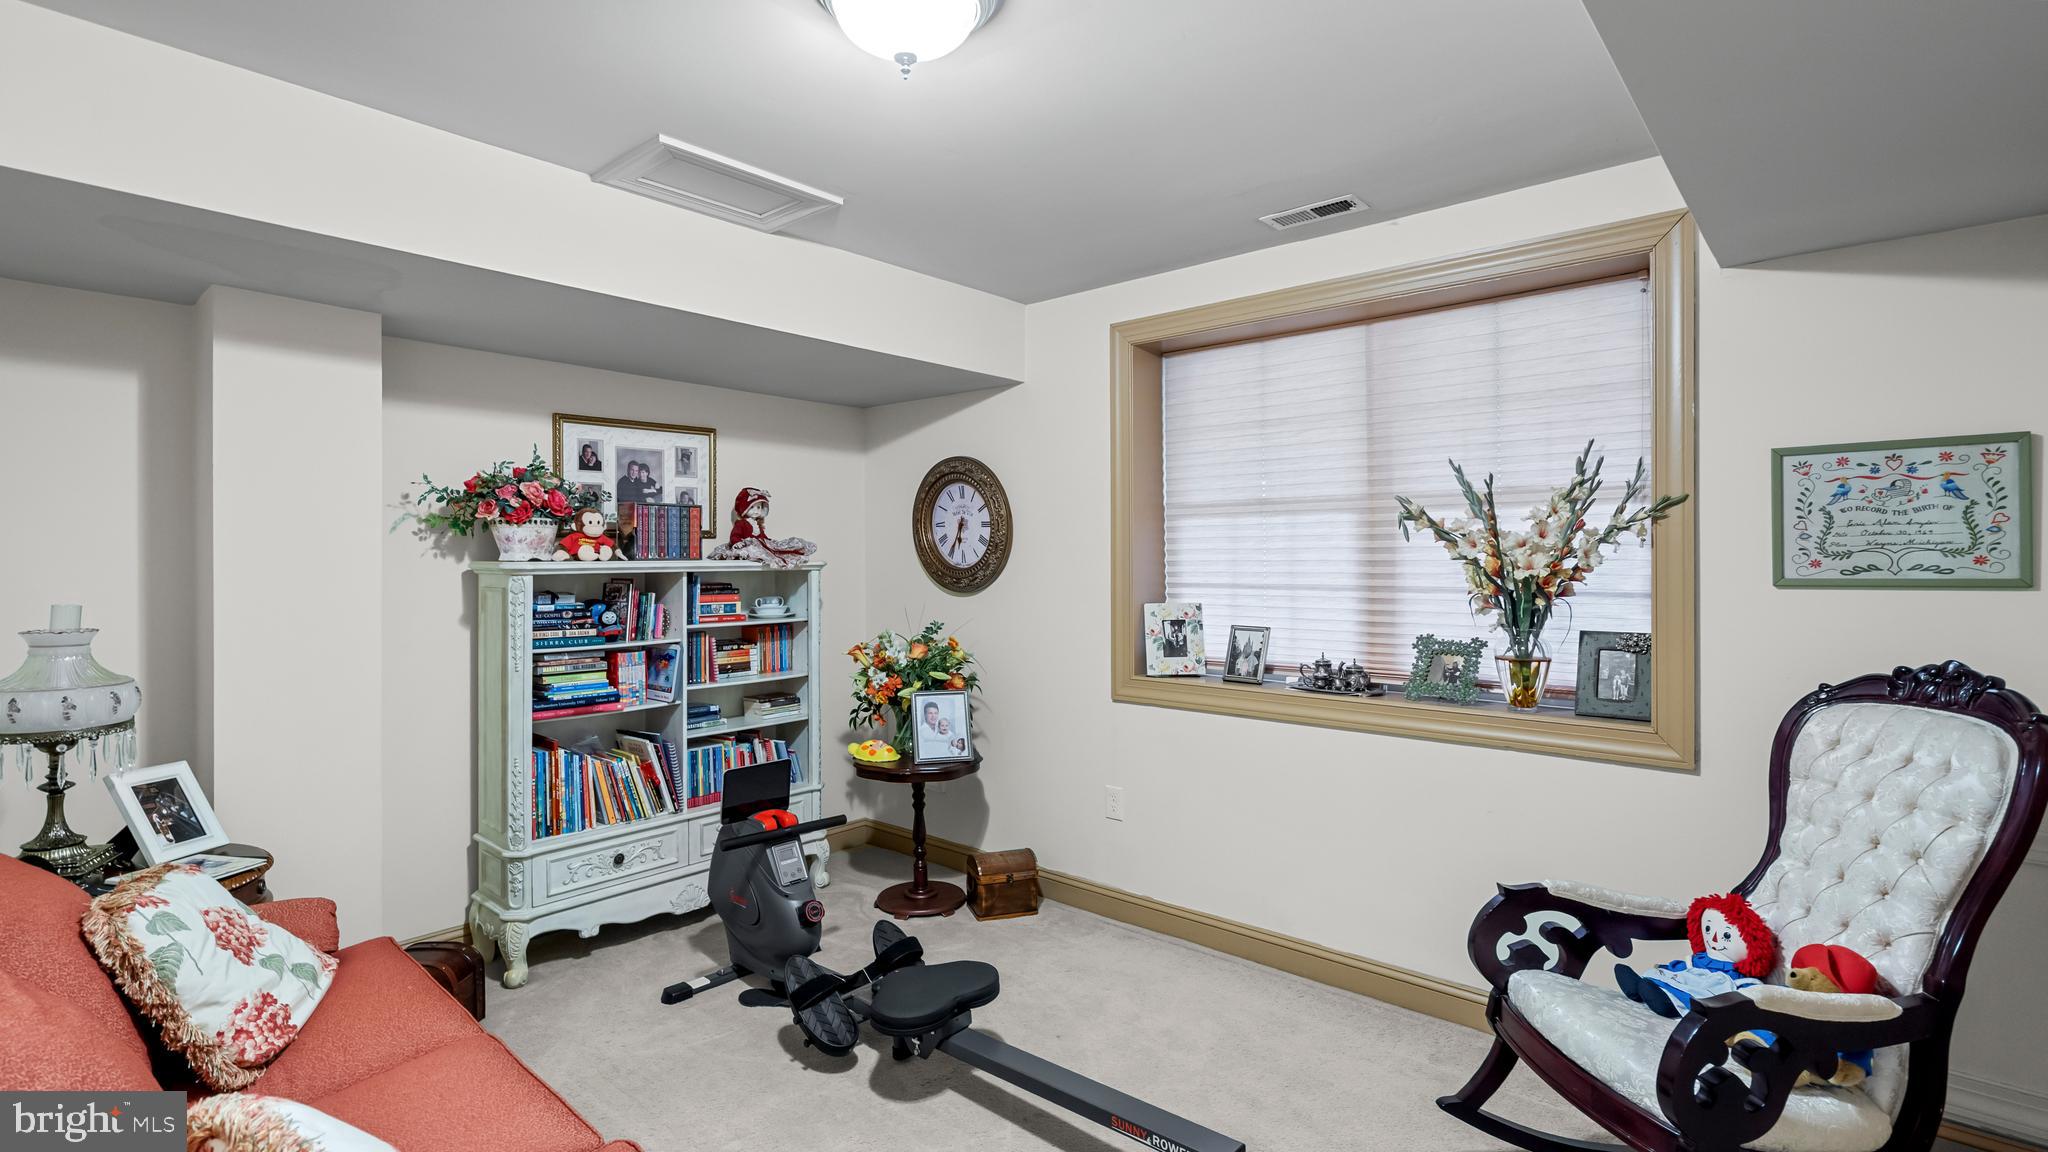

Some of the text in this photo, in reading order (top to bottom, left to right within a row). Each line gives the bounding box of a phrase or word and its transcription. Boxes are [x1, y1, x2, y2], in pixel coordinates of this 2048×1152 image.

[1855, 505, 1888, 515] RECORD
[1911, 503, 1940, 514] BIRTH
[1111, 1115, 1148, 1140] SUNNY
